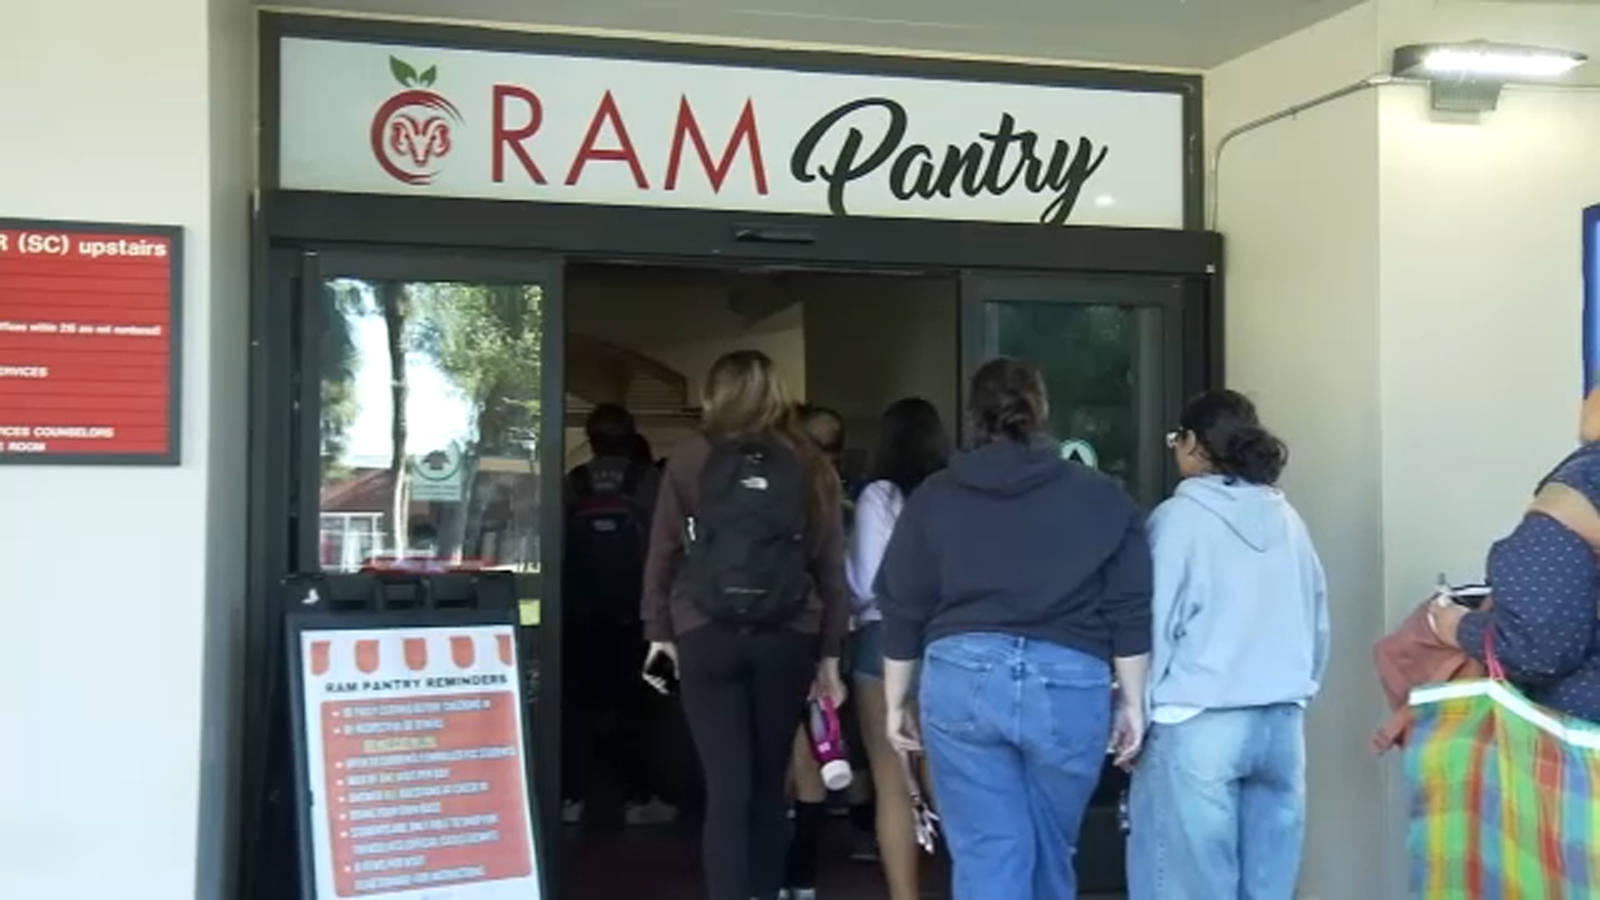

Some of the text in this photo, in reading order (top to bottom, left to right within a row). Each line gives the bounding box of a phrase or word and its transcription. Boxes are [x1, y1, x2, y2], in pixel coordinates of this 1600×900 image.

[491, 84, 1108, 225] RAM Pantry
[18, 232, 69, 255] (SC)
[79, 239, 167, 258] upstairs
[33, 426, 115, 438] COUNSELORS
[325, 674, 508, 693] RAM PANTRY REMINDERS
